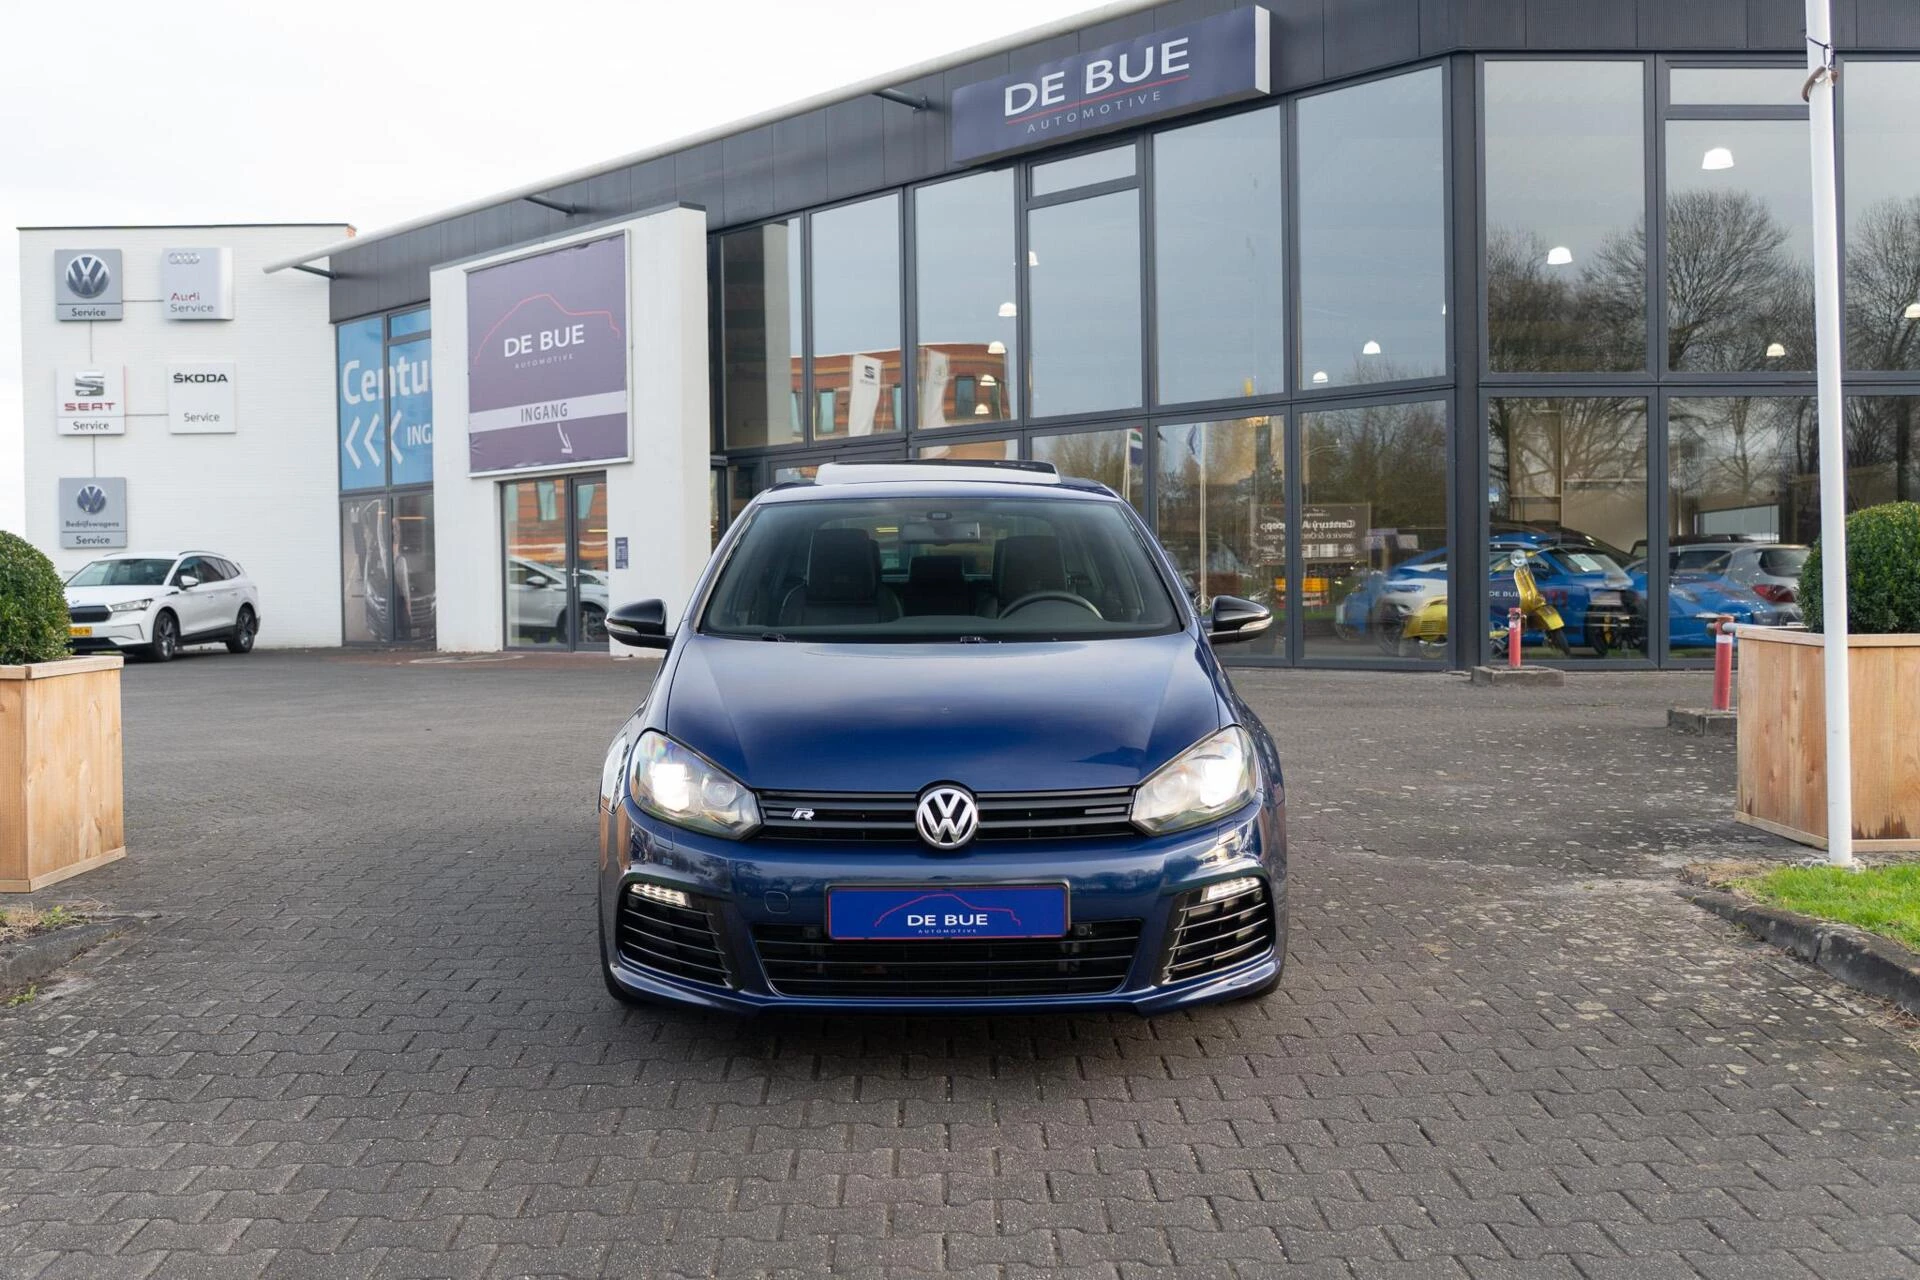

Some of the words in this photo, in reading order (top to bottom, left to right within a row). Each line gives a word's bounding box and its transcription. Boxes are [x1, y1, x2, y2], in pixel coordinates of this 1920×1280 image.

[1004, 70, 1066, 117] DE
[1084, 36, 1190, 94] BUE
[1026, 90, 1162, 134] AUTOMOTIVE
[170, 291, 201, 302] Audi
[71, 307, 107, 318] Service
[170, 303, 215, 314] Service
[503, 333, 534, 358] DE
[540, 323, 585, 351] BUE
[514, 352, 574, 369] AUTOMOTIVE
[173, 372, 229, 384] ŠKODA
[64, 402, 117, 412] SEAT
[520, 402, 569, 423] INGANG
[183, 412, 221, 423] Service
[73, 420, 110, 431] Service
[75, 535, 111, 545] Service
[906, 914, 937, 927] DE
[944, 913, 989, 926] BUE
